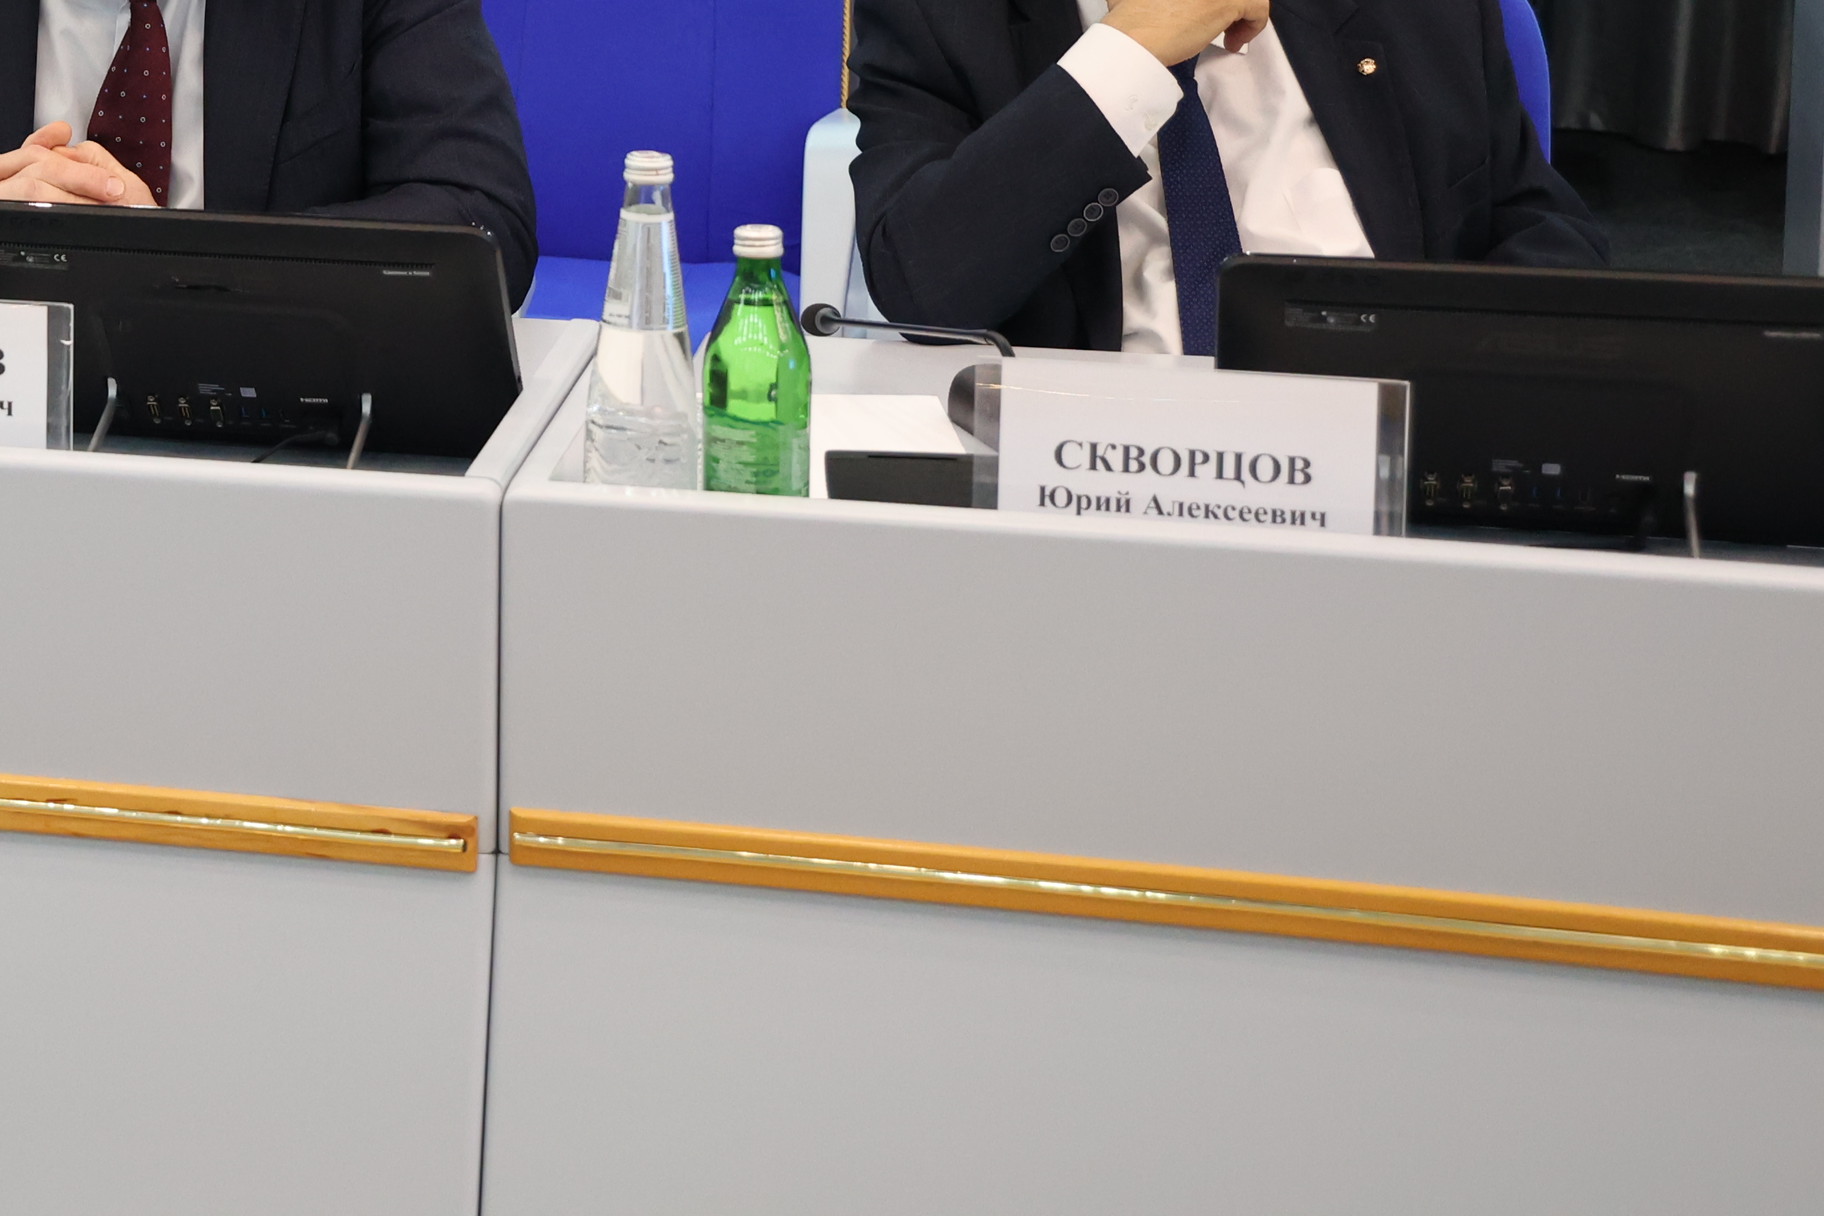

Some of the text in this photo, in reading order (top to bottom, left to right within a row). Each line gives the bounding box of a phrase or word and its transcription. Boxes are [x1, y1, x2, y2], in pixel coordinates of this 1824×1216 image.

[1053, 439, 1313, 488] СКВОРЦОВ
[1038, 484, 1327, 528] Юрий Алексеевич
